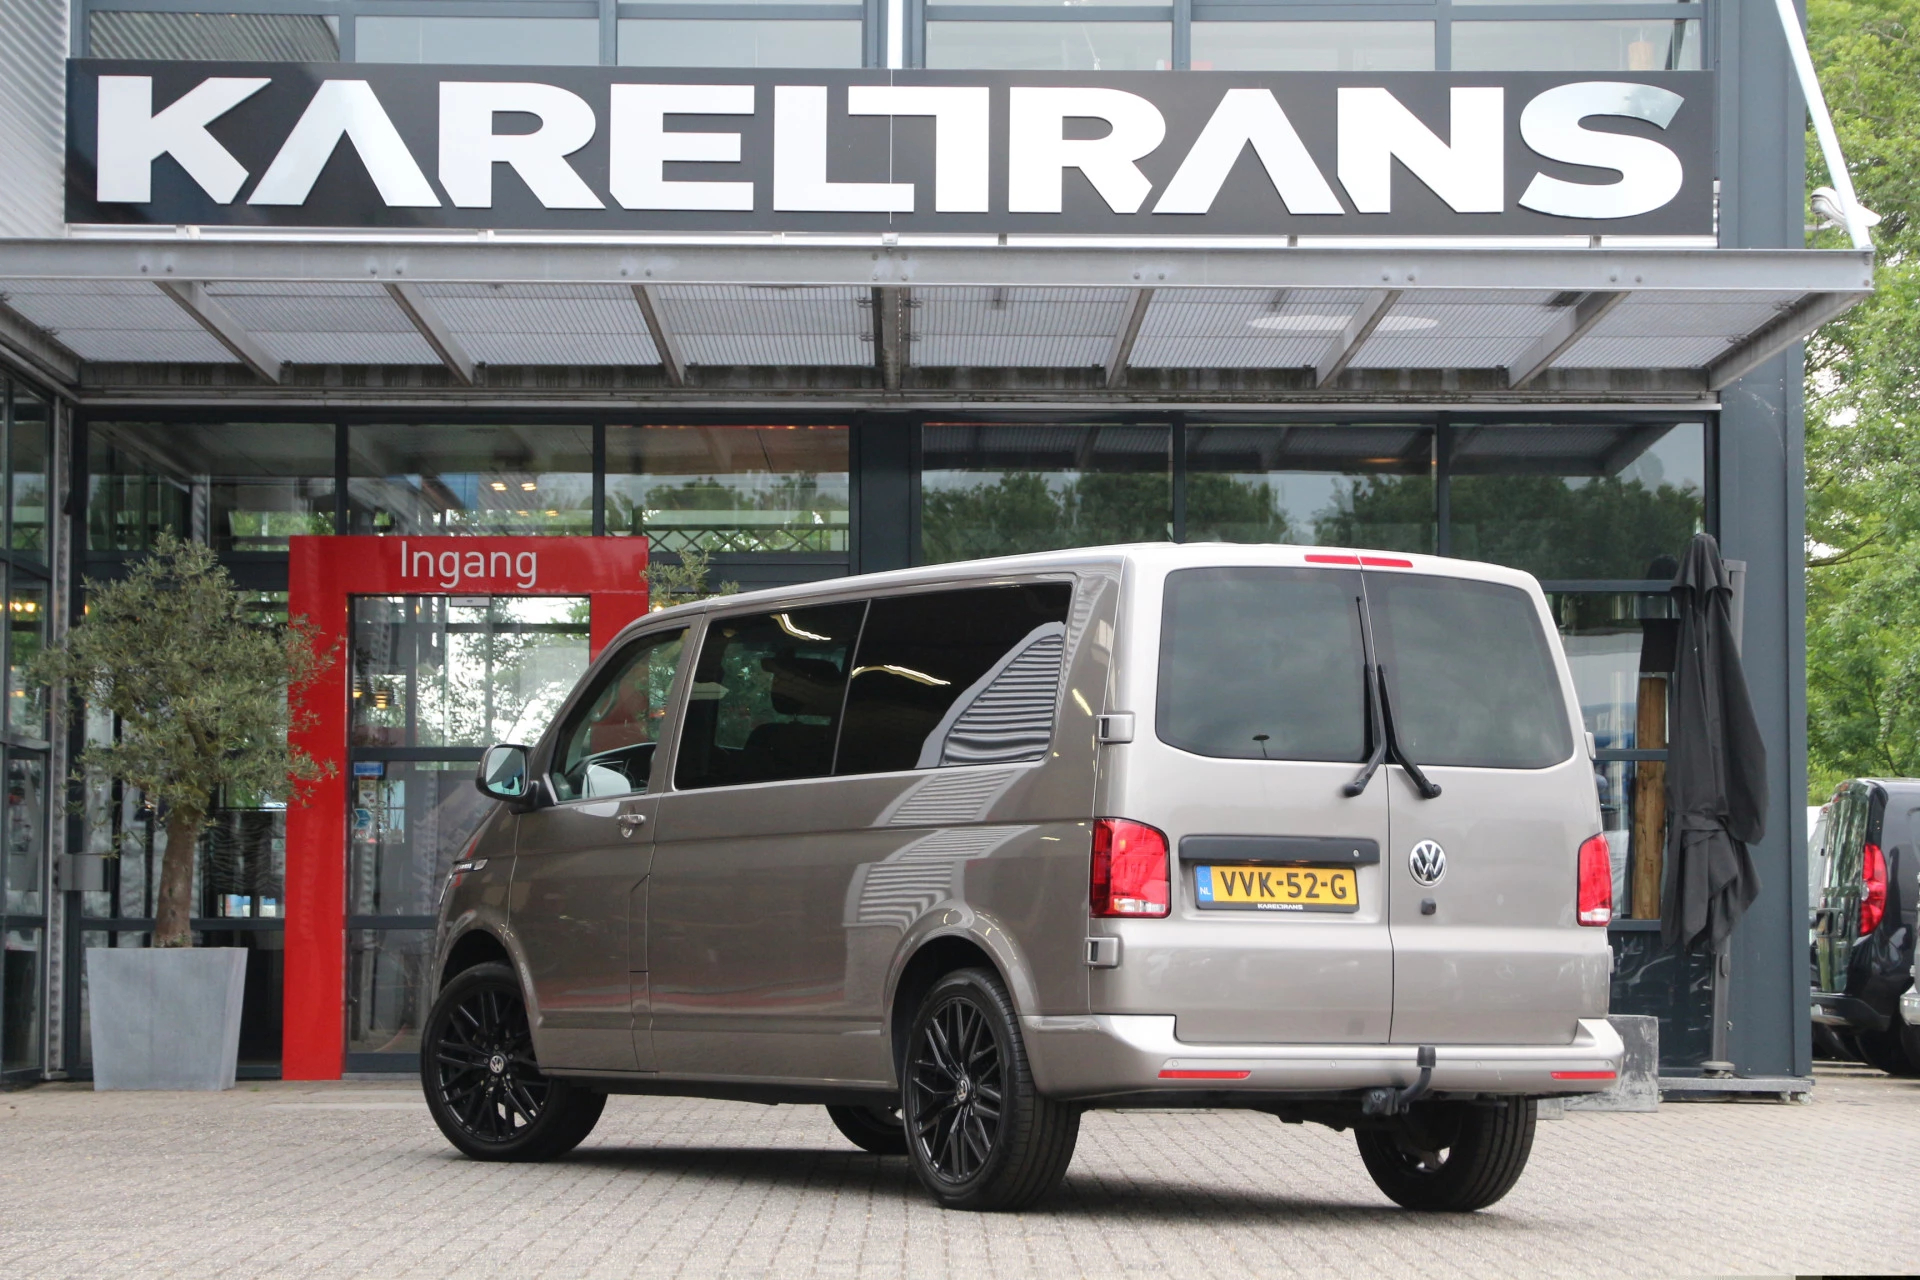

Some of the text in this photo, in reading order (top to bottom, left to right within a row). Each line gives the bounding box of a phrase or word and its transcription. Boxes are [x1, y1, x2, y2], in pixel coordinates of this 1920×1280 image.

[96, 74, 1686, 220] KARELTRANS
[401, 540, 537, 589] Ingang
[1199, 886, 1212, 896] NL
[1220, 871, 1348, 899] VVK-52-G
